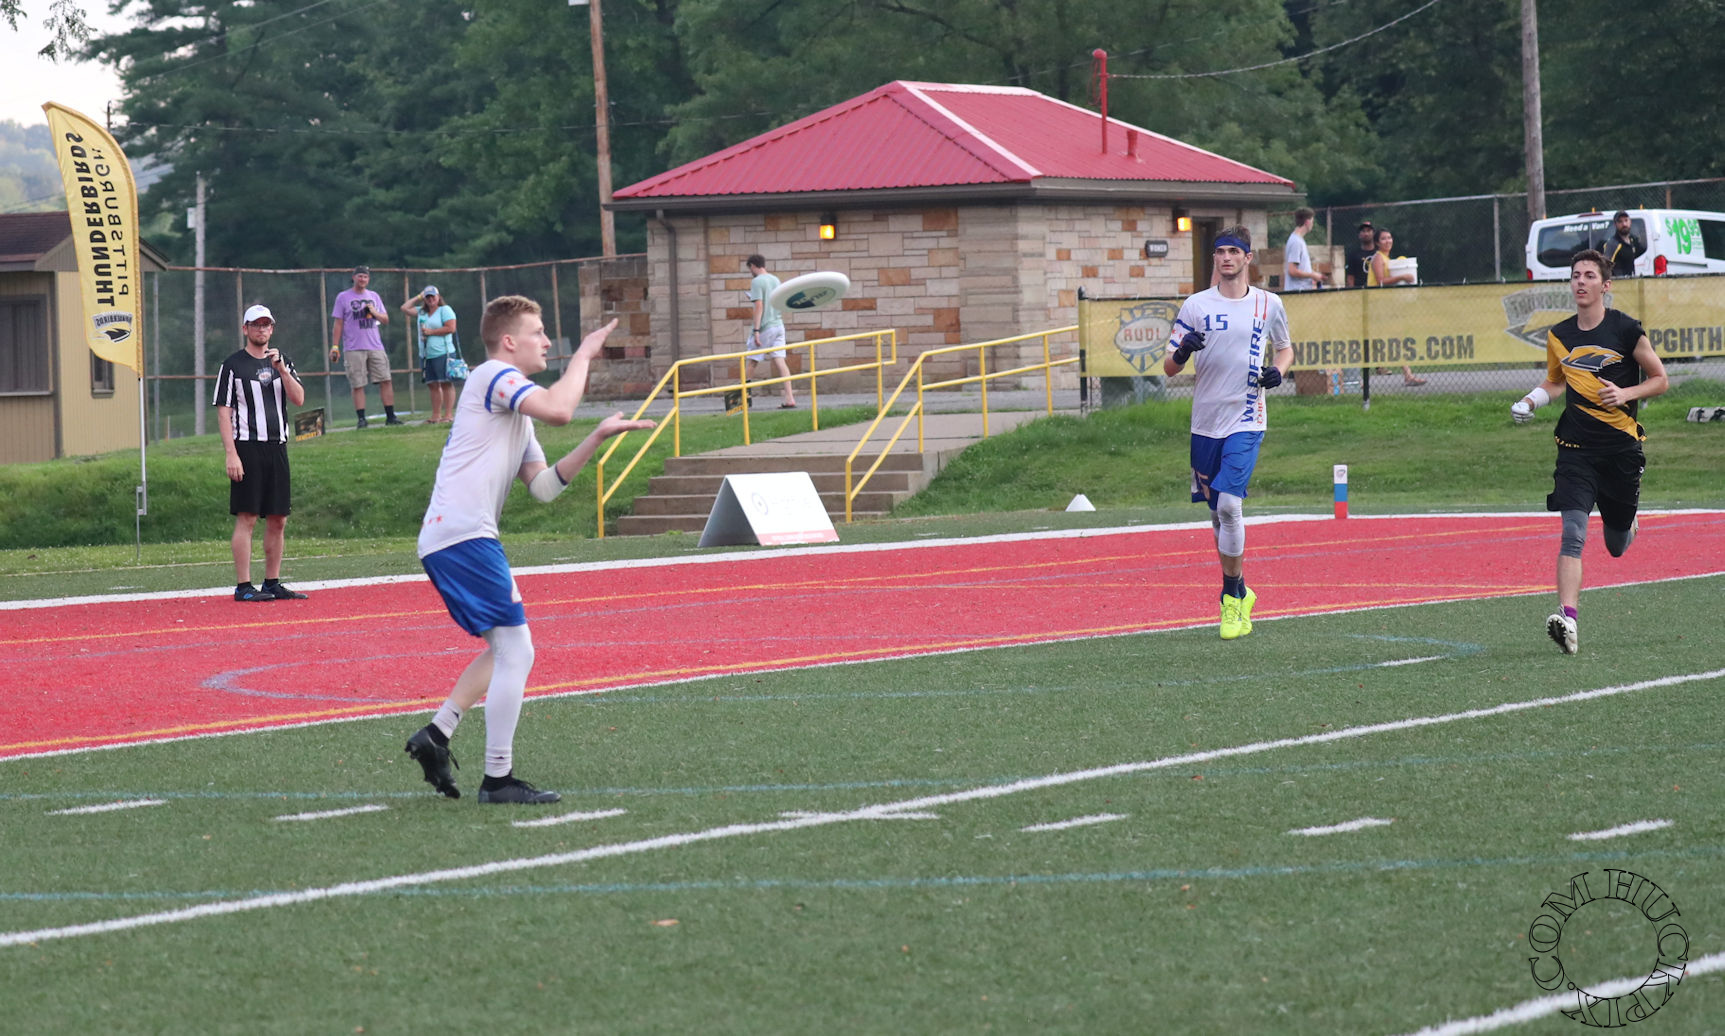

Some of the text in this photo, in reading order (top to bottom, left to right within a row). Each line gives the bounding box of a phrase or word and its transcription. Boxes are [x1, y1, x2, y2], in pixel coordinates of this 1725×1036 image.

[1203, 314, 1229, 331] 15
[1649, 326, 1725, 353] PGHTH
[1241, 318, 1264, 422] WILDFIRE
